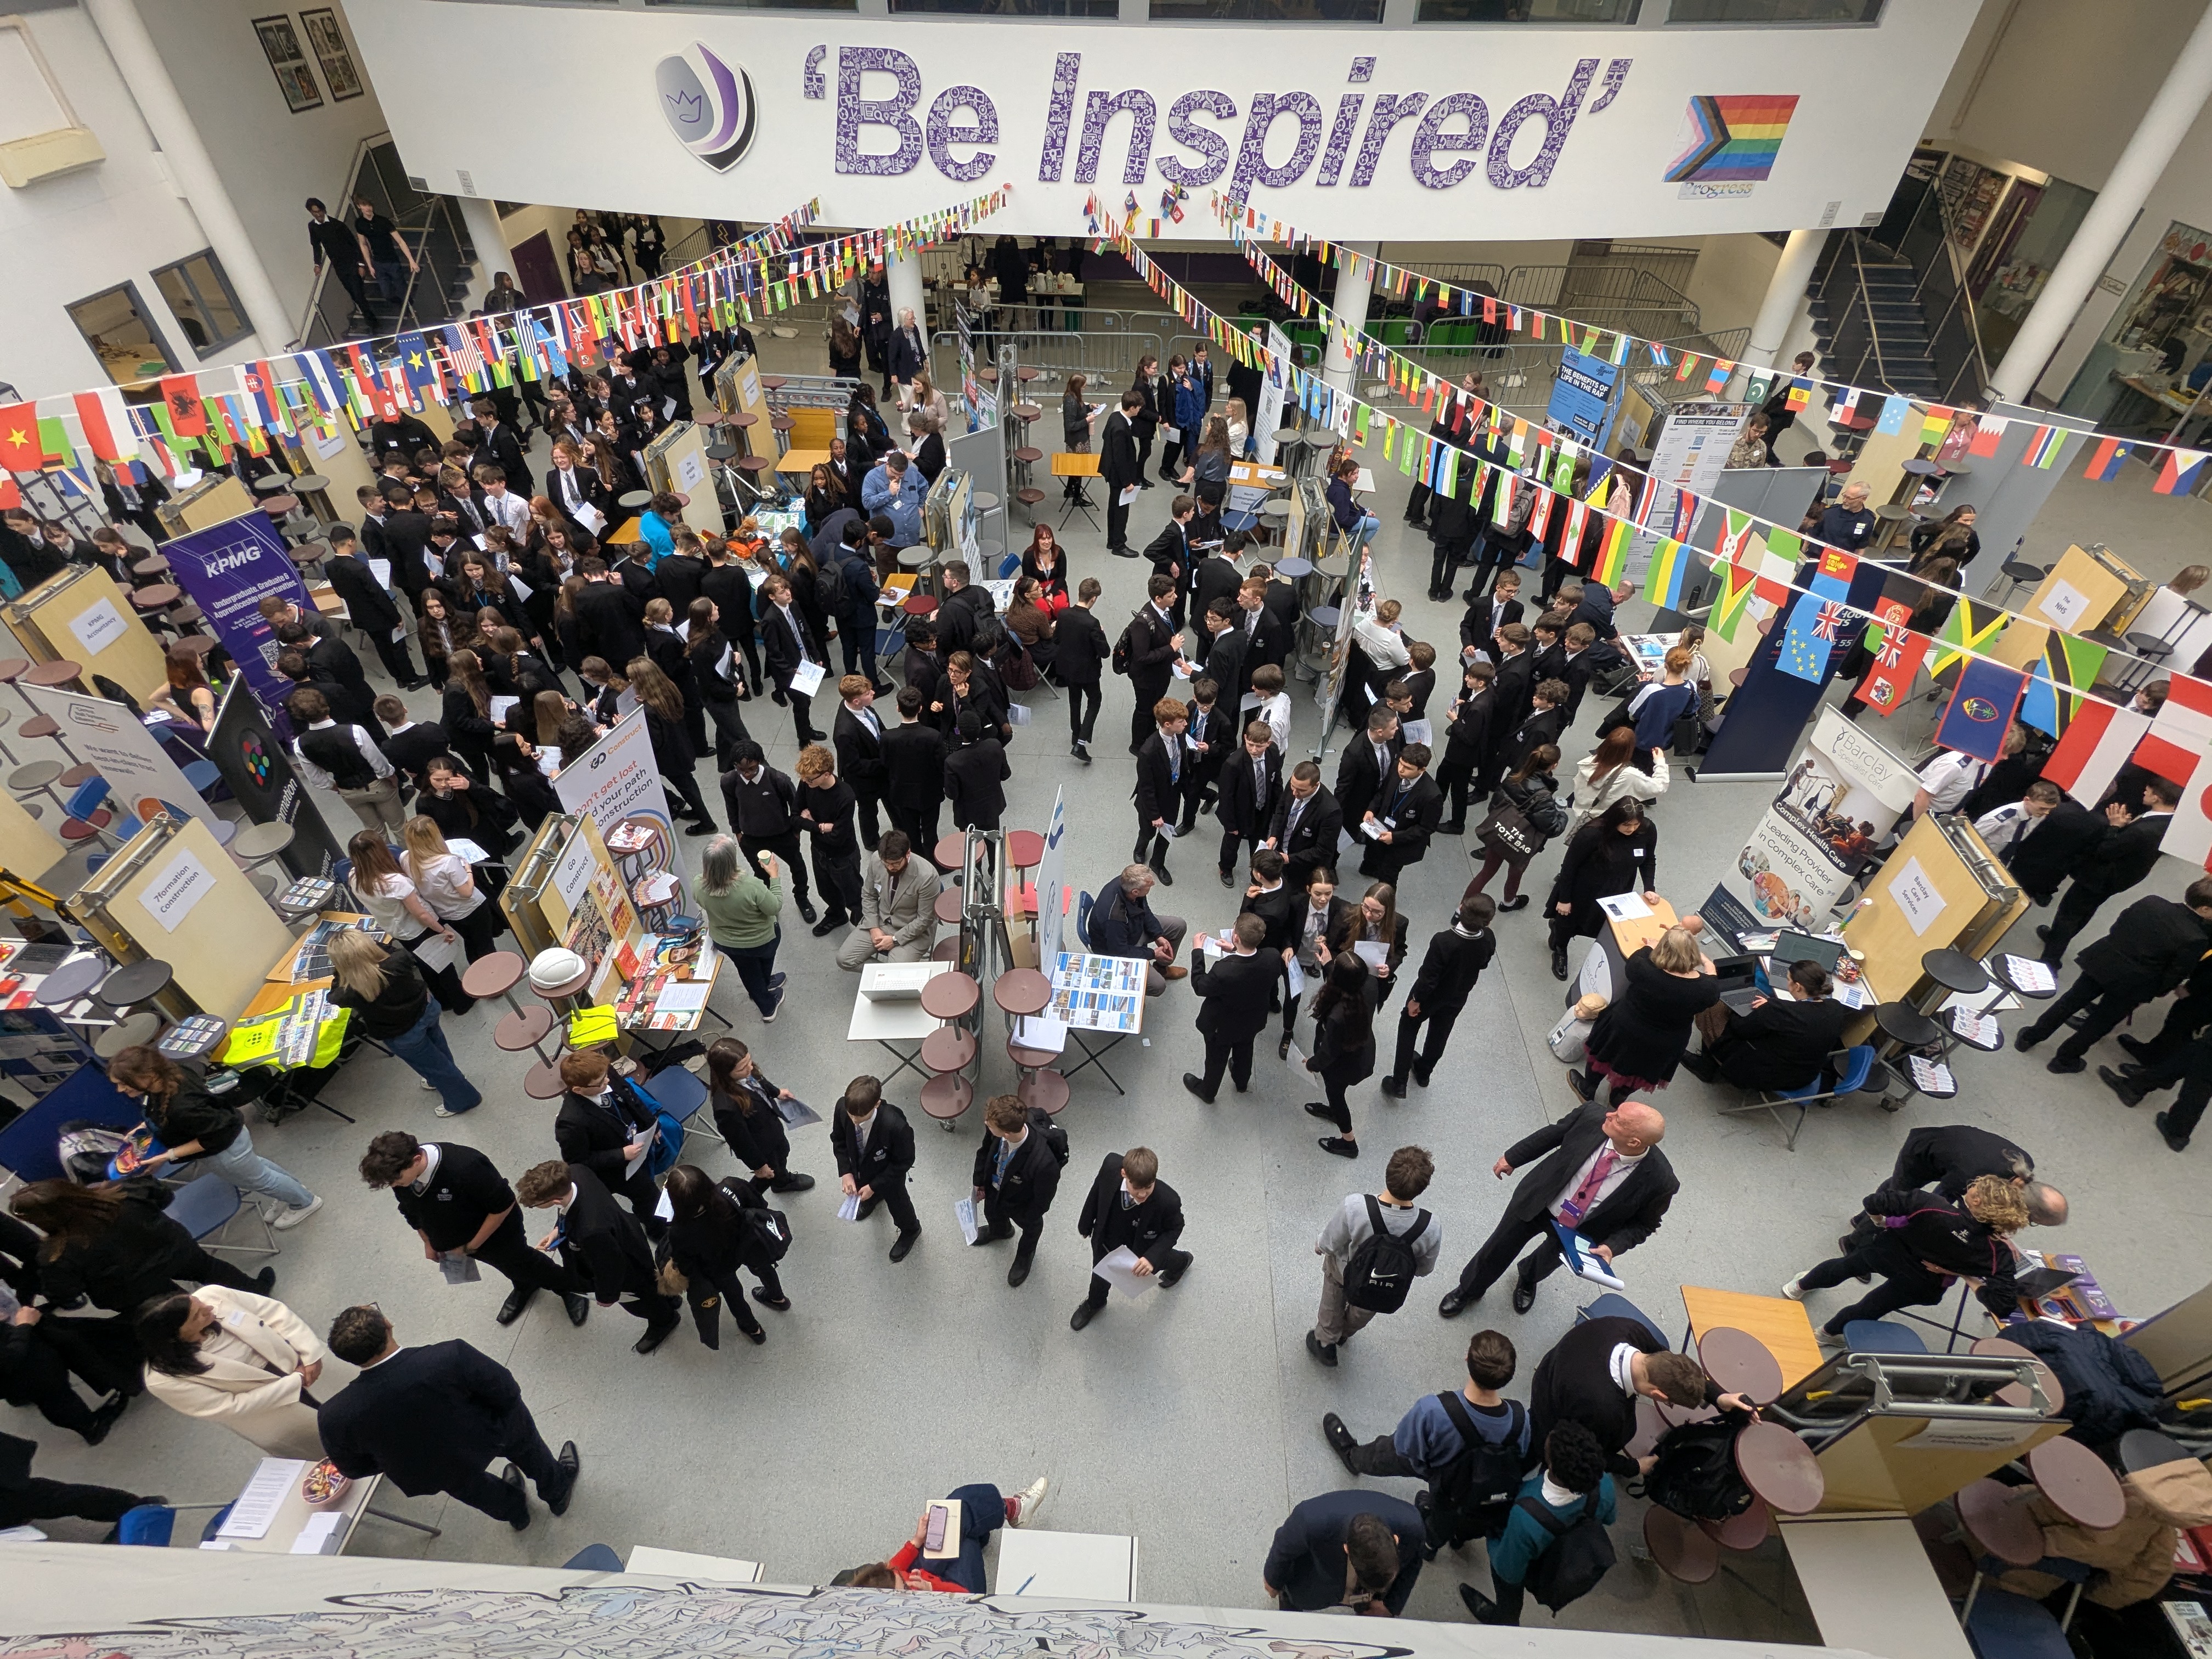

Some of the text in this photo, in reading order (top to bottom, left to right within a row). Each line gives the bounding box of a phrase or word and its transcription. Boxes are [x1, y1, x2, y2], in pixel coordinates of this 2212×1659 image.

[1684, 182, 1753, 199] Progress
[1271, 331, 1287, 354] WELCOME TO
[1560, 373, 1572, 382] LIFE
[1580, 382, 1592, 392] THE
[1592, 387, 1604, 398] RAF
[1561, 365, 1573, 376] THE
[1572, 371, 1599, 388] BENEFITS
[206, 546, 261, 578] KPMG
[257, 575, 284, 590] Graduate
[214, 597, 257, 618] Apprenticeship
[258, 580, 298, 602] opportunities.
[2055, 602, 2067, 614] NHS
[87, 617, 117, 640] Accountancy
[88, 614, 104, 627] KPMG
[84, 743, 98, 752] We
[608, 724, 642, 755] Construct
[1838, 749, 1883, 790] Specialist Care
[1843, 735, 1893, 781] Barclay
[600, 768, 646, 811] your path
[601, 776, 618, 795] get
[619, 760, 638, 780] lost
[1495, 822, 1531, 854] TOTE BAG
[1511, 827, 1525, 840] THE
[1776, 802, 1846, 868] Complex Health Care
[1758, 831, 1824, 896] in Complex Care
[1765, 819, 1833, 884] Leading Provider
[566, 856, 589, 894] Construct
[568, 859, 576, 871] Go
[154, 865, 190, 902] 7formation
[160, 871, 200, 913] Construction
[1911, 888, 1921, 902] Care
[1914, 876, 1929, 899] Barclay
[1902, 890, 1918, 915] Services
[722, 1187, 733, 1196] AIR
[1369, 1279, 1393, 1288] AIR
